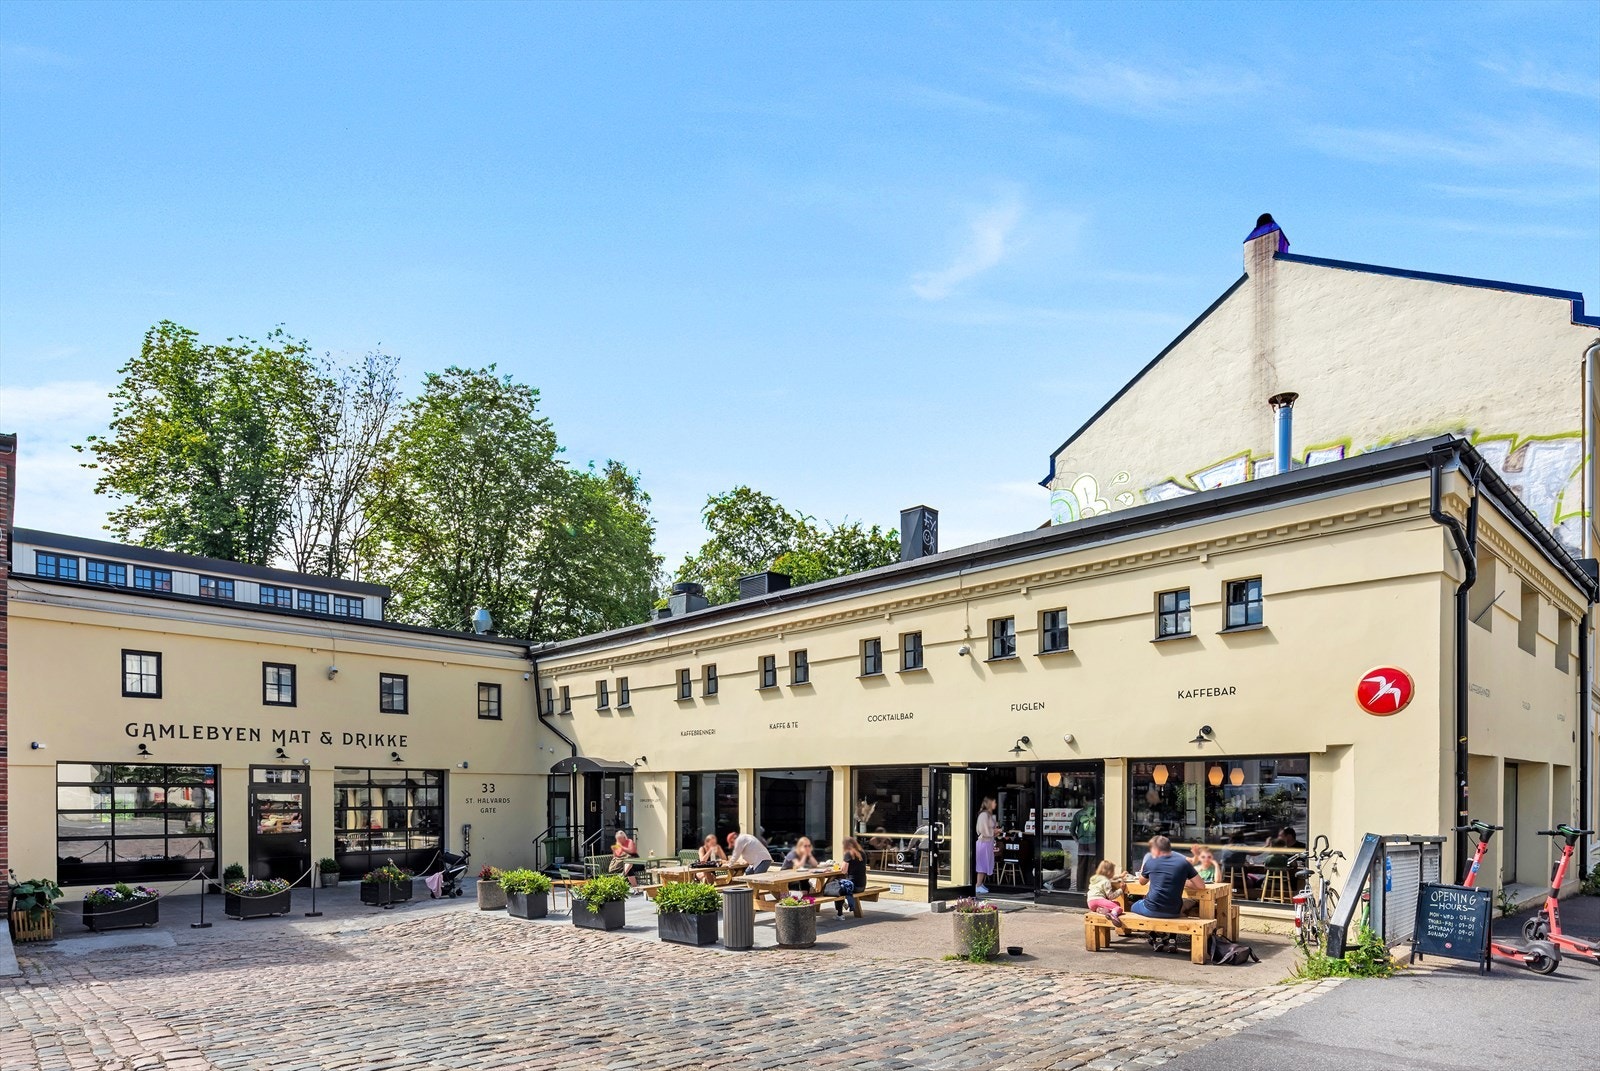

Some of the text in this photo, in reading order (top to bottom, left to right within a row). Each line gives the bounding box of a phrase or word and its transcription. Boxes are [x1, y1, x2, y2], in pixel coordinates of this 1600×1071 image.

[1177, 686, 1237, 699] KAFFEBAR
[1010, 702, 1045, 712] FUGLEN
[867, 712, 914, 722] COCKTAILBAR
[769, 721, 799, 730] KAFFE & TE
[125, 722, 408, 749] GAMLEBYEN MAT & DRIKKE
[481, 783, 496, 793] 33
[1431, 891, 1476, 905] OPENING
[1427, 930, 1448, 938] SUNDAY
[1428, 925, 1454, 934] SATURDAY
